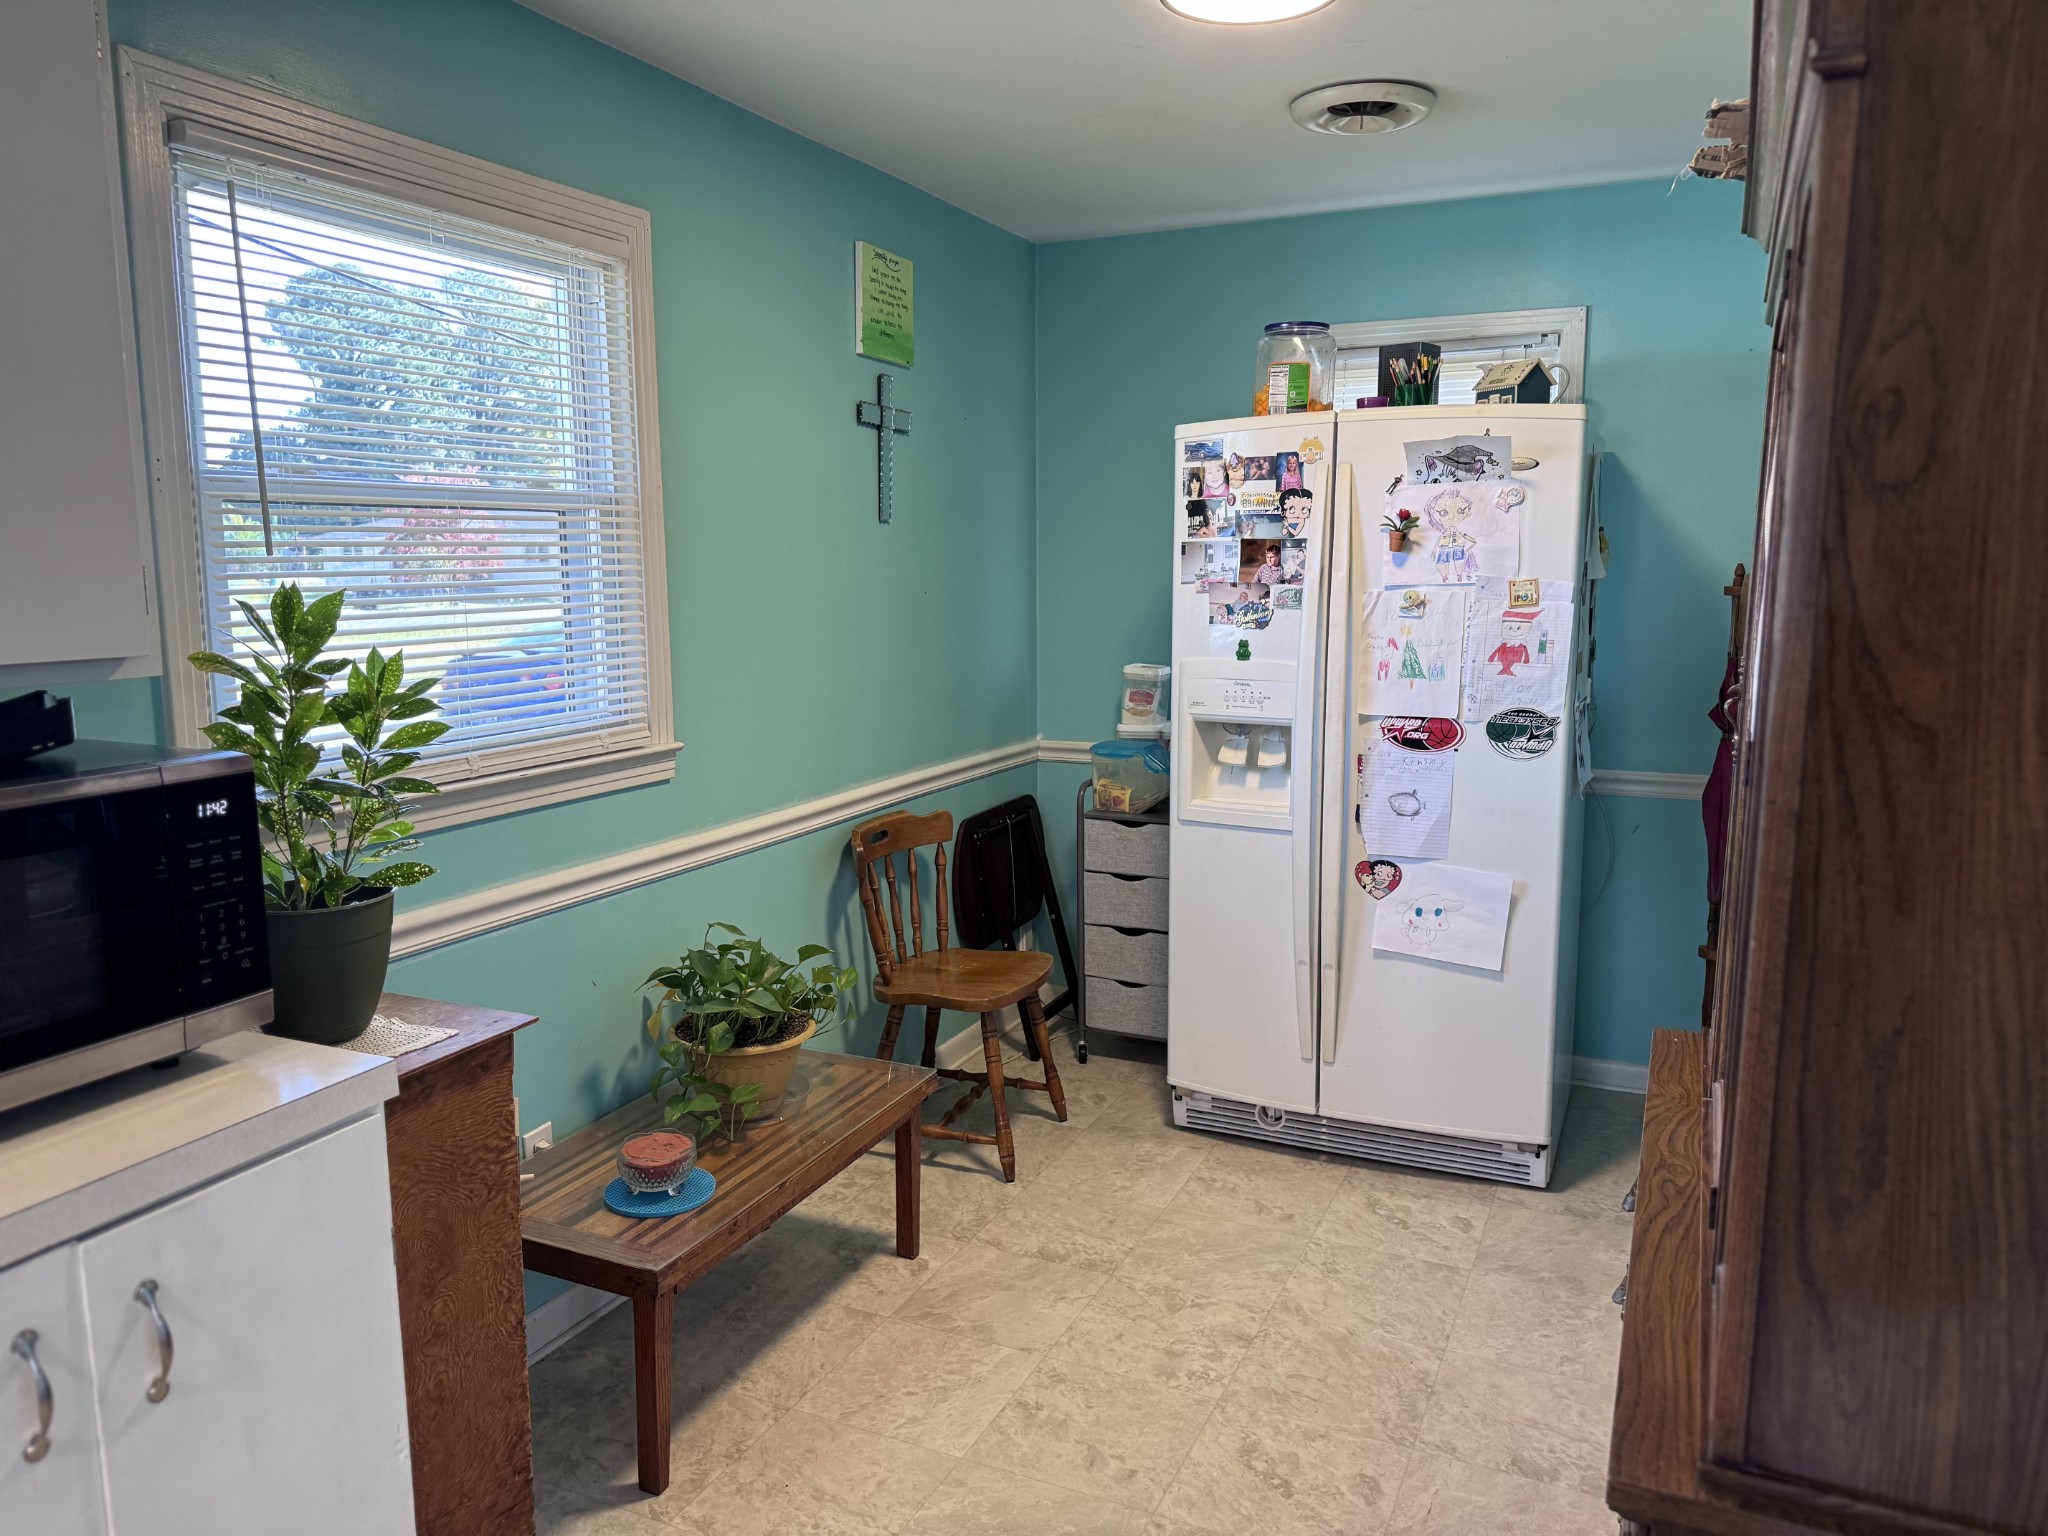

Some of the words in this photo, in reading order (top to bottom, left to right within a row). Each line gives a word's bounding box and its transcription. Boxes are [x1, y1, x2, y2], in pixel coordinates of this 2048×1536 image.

[1381, 717, 1422, 727] UPWARD
[197, 800, 228, 818] 11:42
[219, 909, 224, 918] 2
[220, 922, 226, 931] 5
[201, 941, 206, 950] 7
[240, 931, 246, 939] 9
[222, 952, 228, 960] 0
